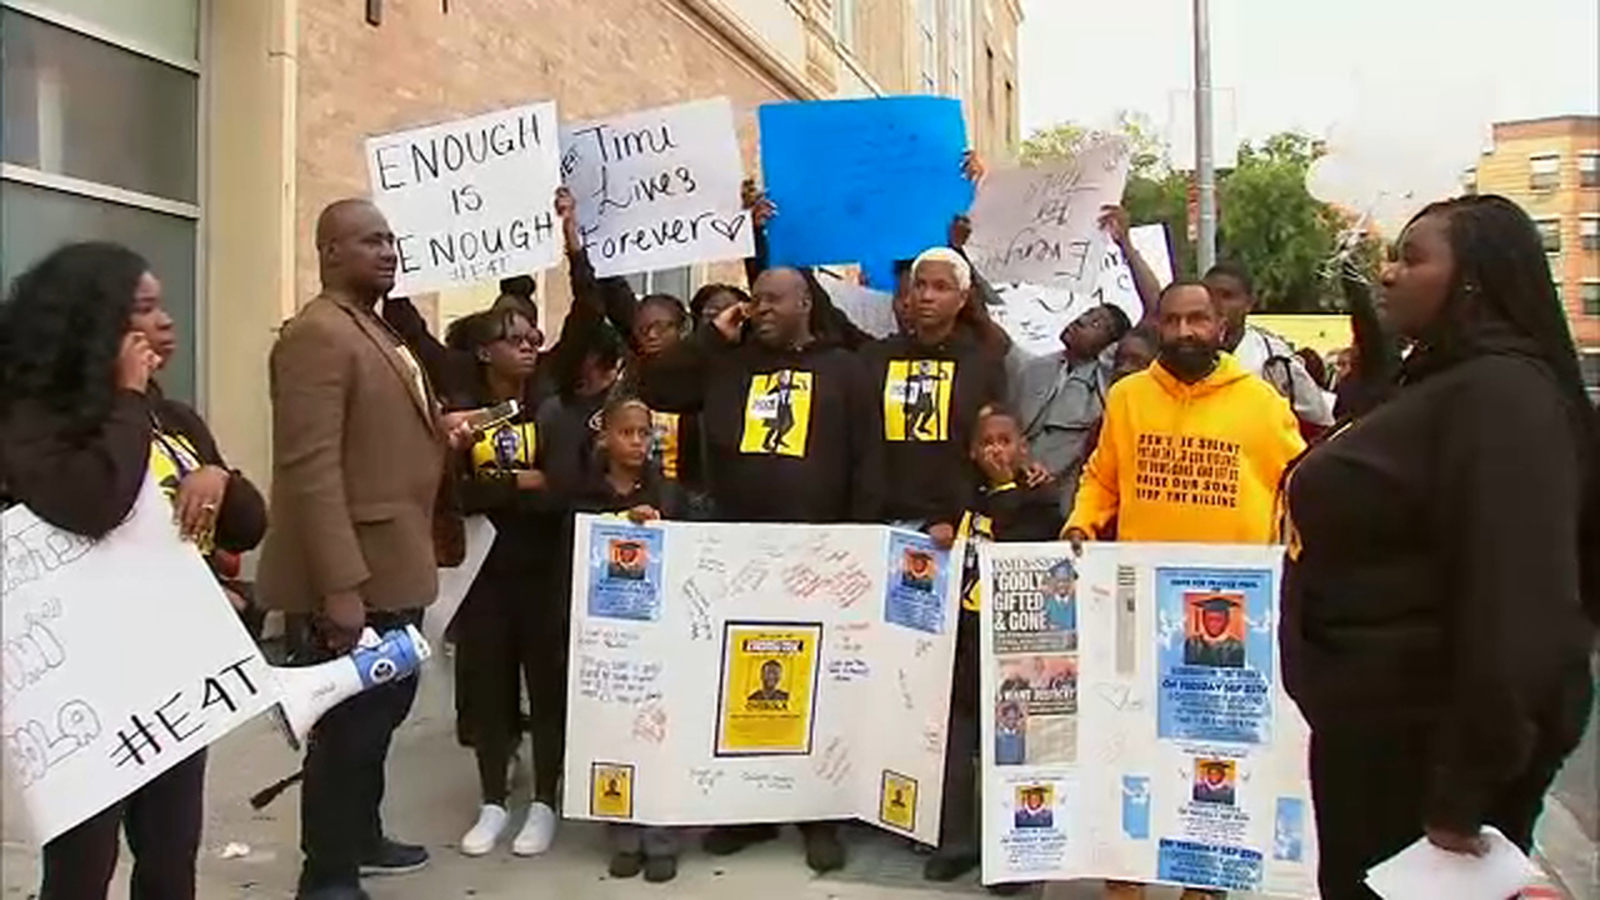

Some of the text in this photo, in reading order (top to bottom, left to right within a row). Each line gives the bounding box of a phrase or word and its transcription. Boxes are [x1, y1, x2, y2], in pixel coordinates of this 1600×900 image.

[376, 113, 542, 191] ENOUGH
[450, 185, 482, 215] IS
[592, 166, 697, 215] Lives
[398, 211, 553, 274] ENOUGH
[994, 591, 1045, 611] GIFTED
[994, 611, 1049, 631] & GONE
